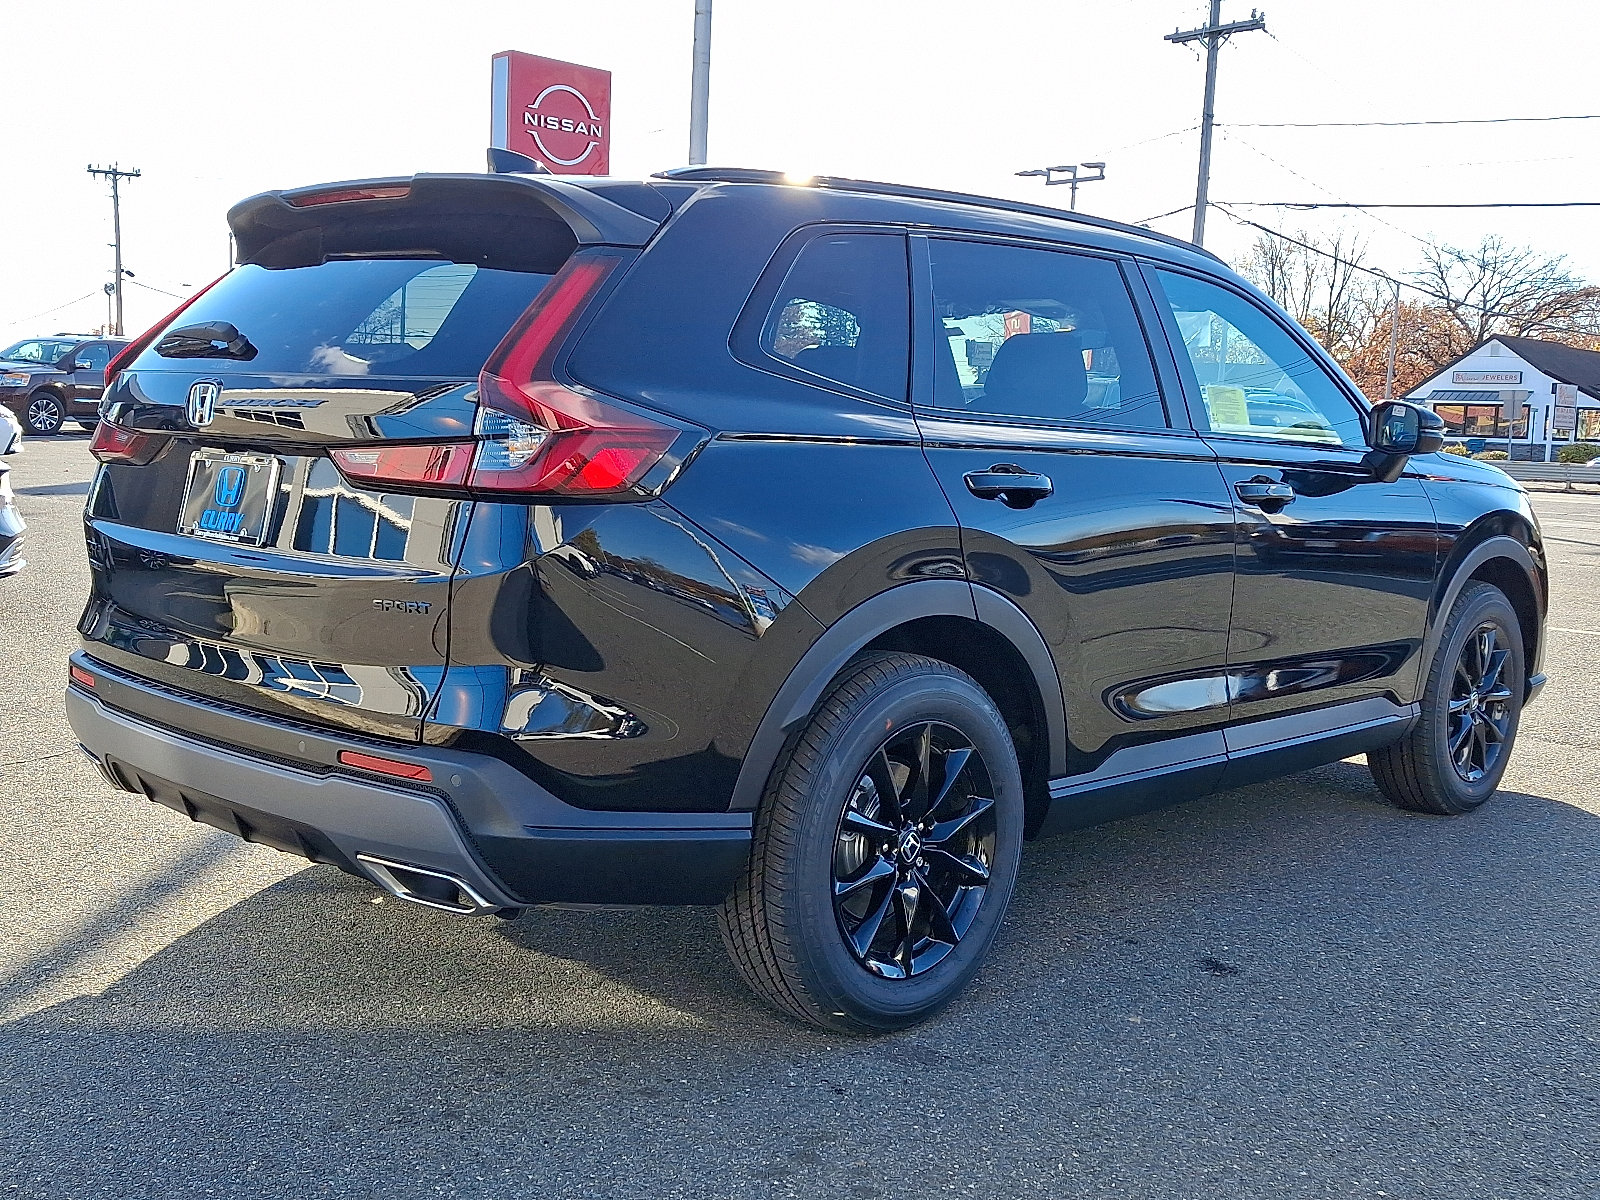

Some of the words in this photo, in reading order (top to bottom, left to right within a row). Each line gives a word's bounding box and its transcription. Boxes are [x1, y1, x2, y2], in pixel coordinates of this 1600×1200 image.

[523, 111, 602, 138] NISSAN
[200, 509, 245, 532] CURRY
[372, 598, 432, 615] SPORT
